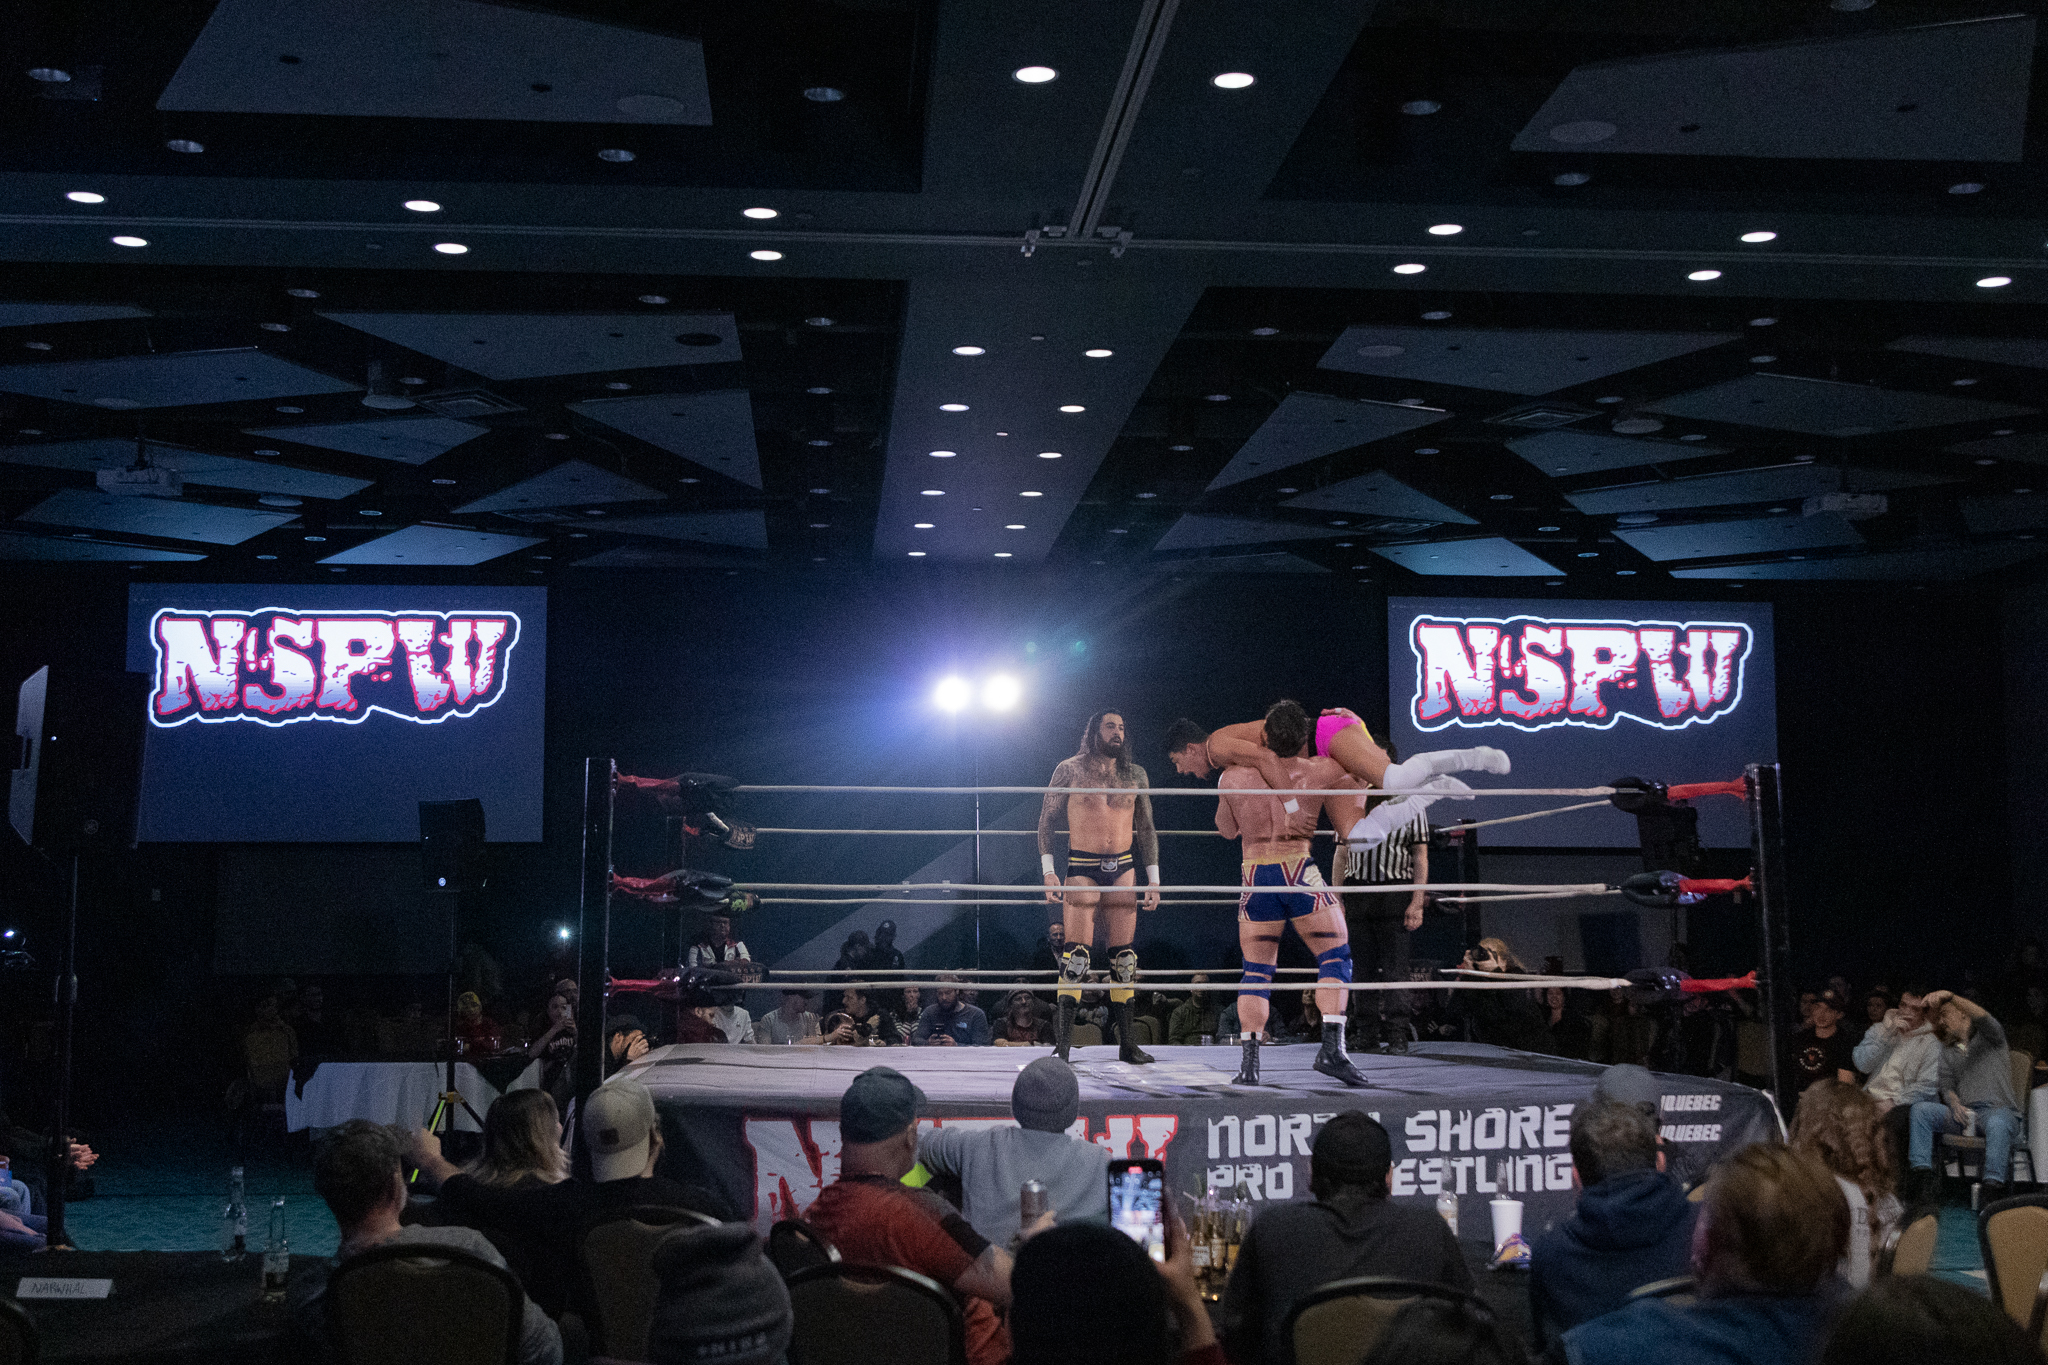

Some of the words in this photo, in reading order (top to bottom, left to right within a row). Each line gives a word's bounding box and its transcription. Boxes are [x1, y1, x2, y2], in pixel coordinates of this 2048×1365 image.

[157, 616, 507, 714] NSPW
[1416, 623, 1740, 720] NSPW
[1207, 1112, 1381, 1159] NOR
[1405, 1103, 1575, 1152] SHORE
[1207, 1162, 1294, 1201] PRO
[1391, 1152, 1574, 1196] ESTLING
